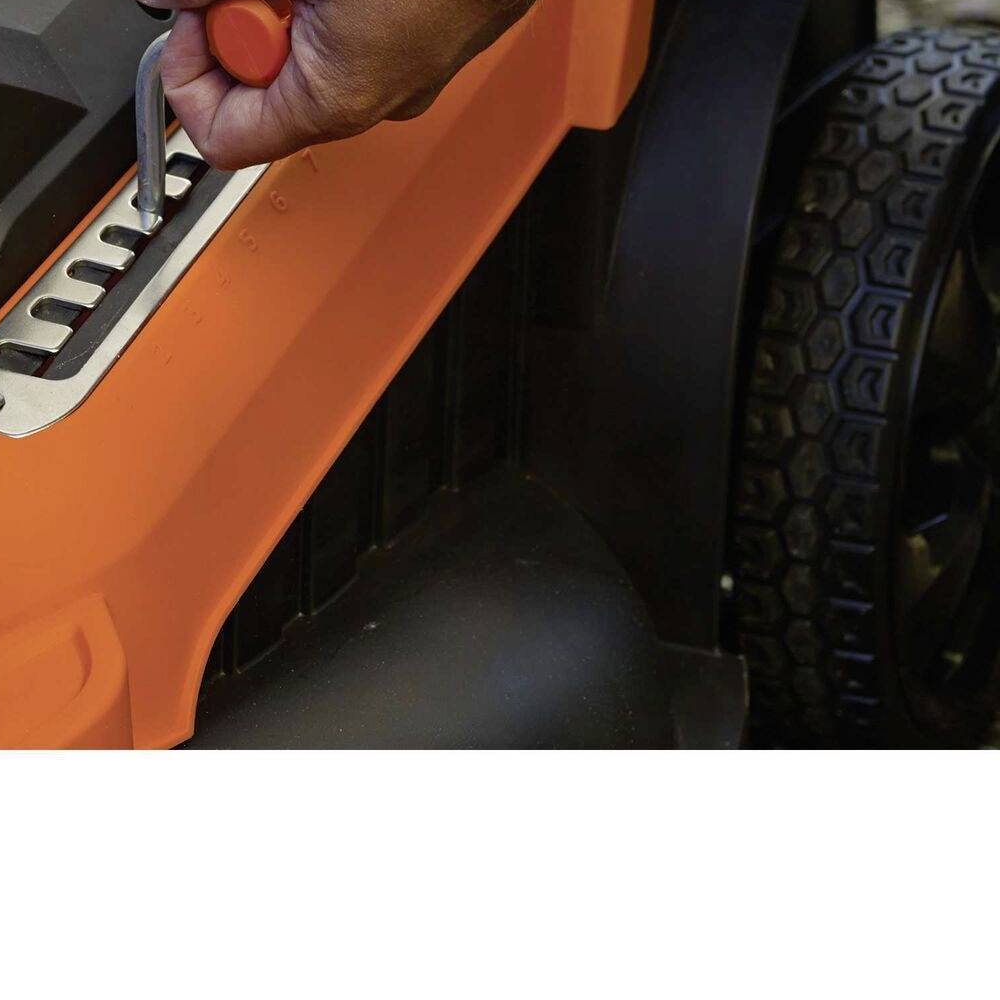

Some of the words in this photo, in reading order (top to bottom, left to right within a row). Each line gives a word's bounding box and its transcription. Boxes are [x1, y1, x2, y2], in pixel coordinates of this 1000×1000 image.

[301, 148, 320, 174] 7
[269, 190, 288, 214] 6
[239, 226, 259, 252] 5
